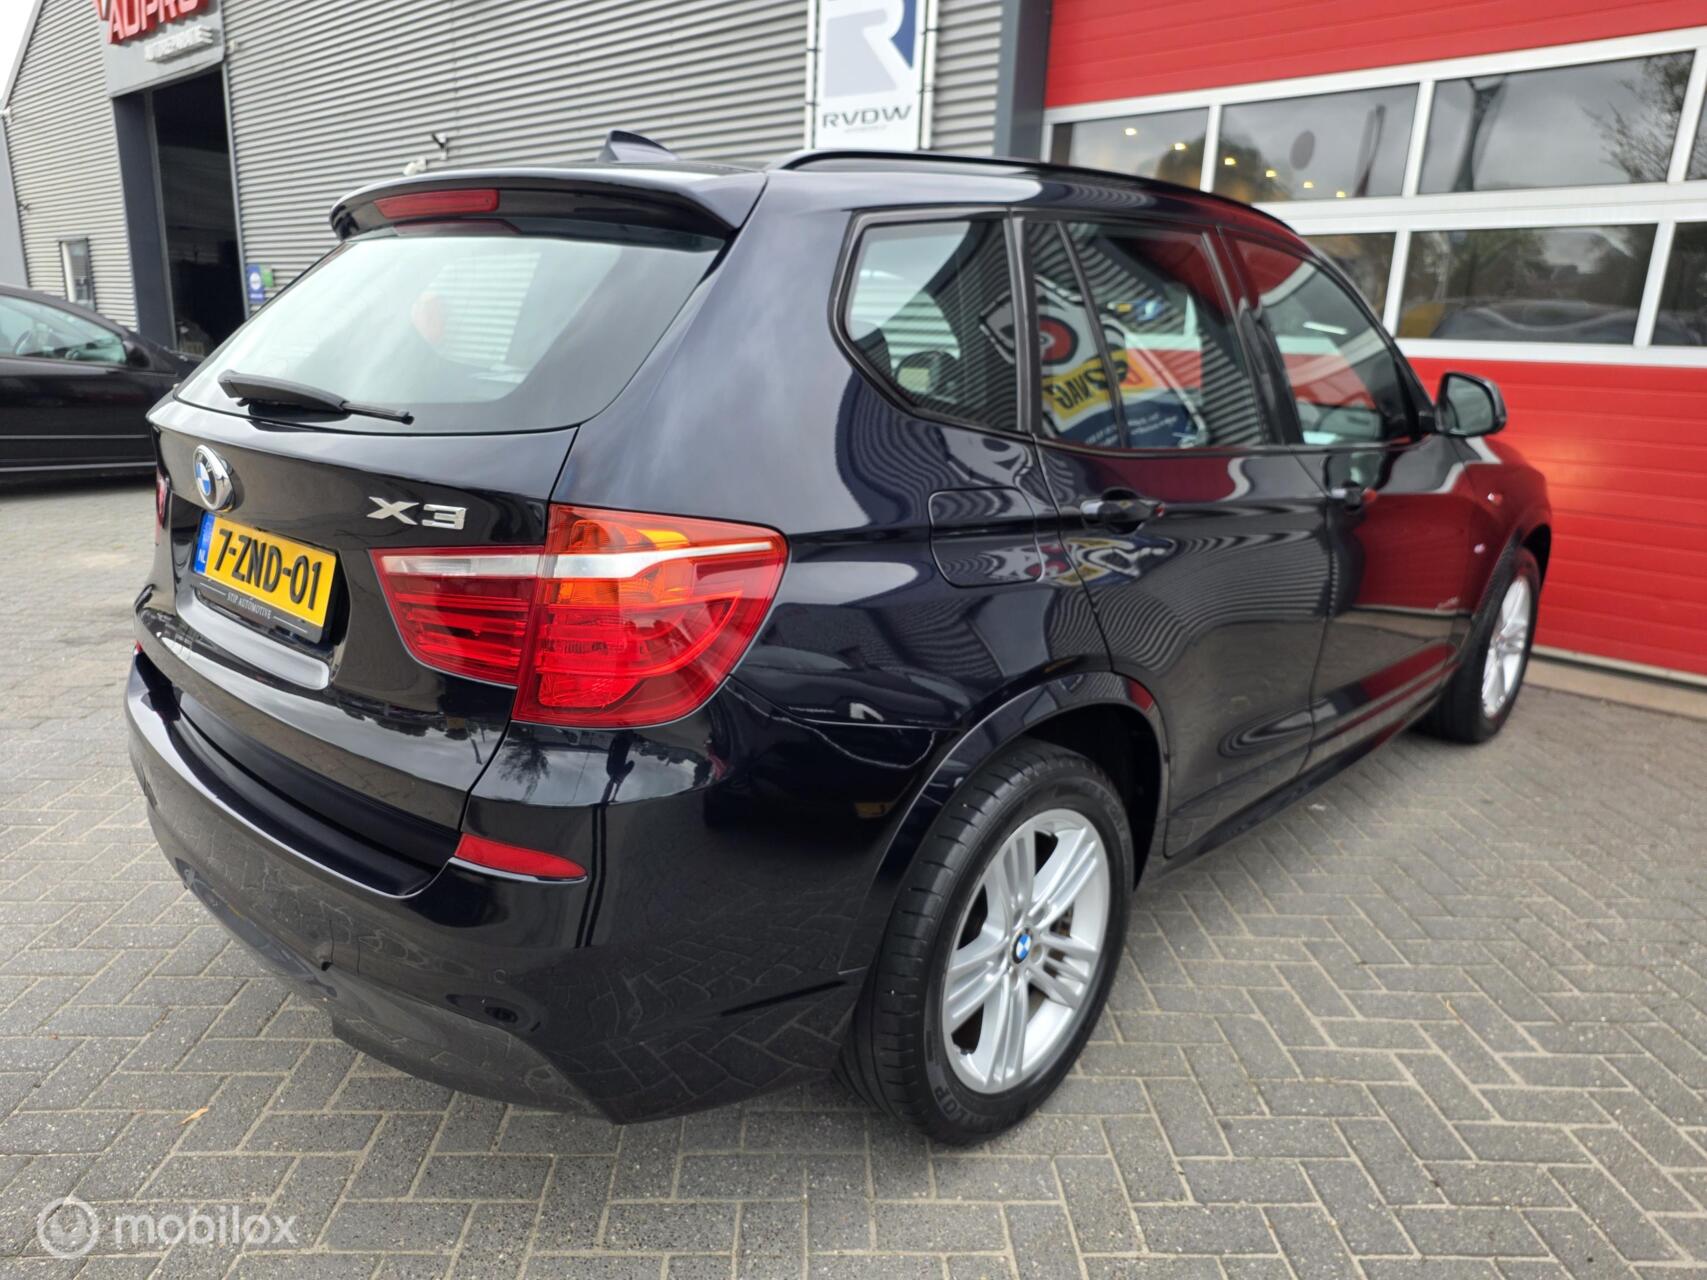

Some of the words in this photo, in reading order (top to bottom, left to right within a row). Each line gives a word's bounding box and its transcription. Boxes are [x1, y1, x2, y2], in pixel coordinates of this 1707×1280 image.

[822, 105, 912, 129] RVDW
[366, 496, 468, 530] X3
[214, 528, 323, 611] 7-ZND-01
